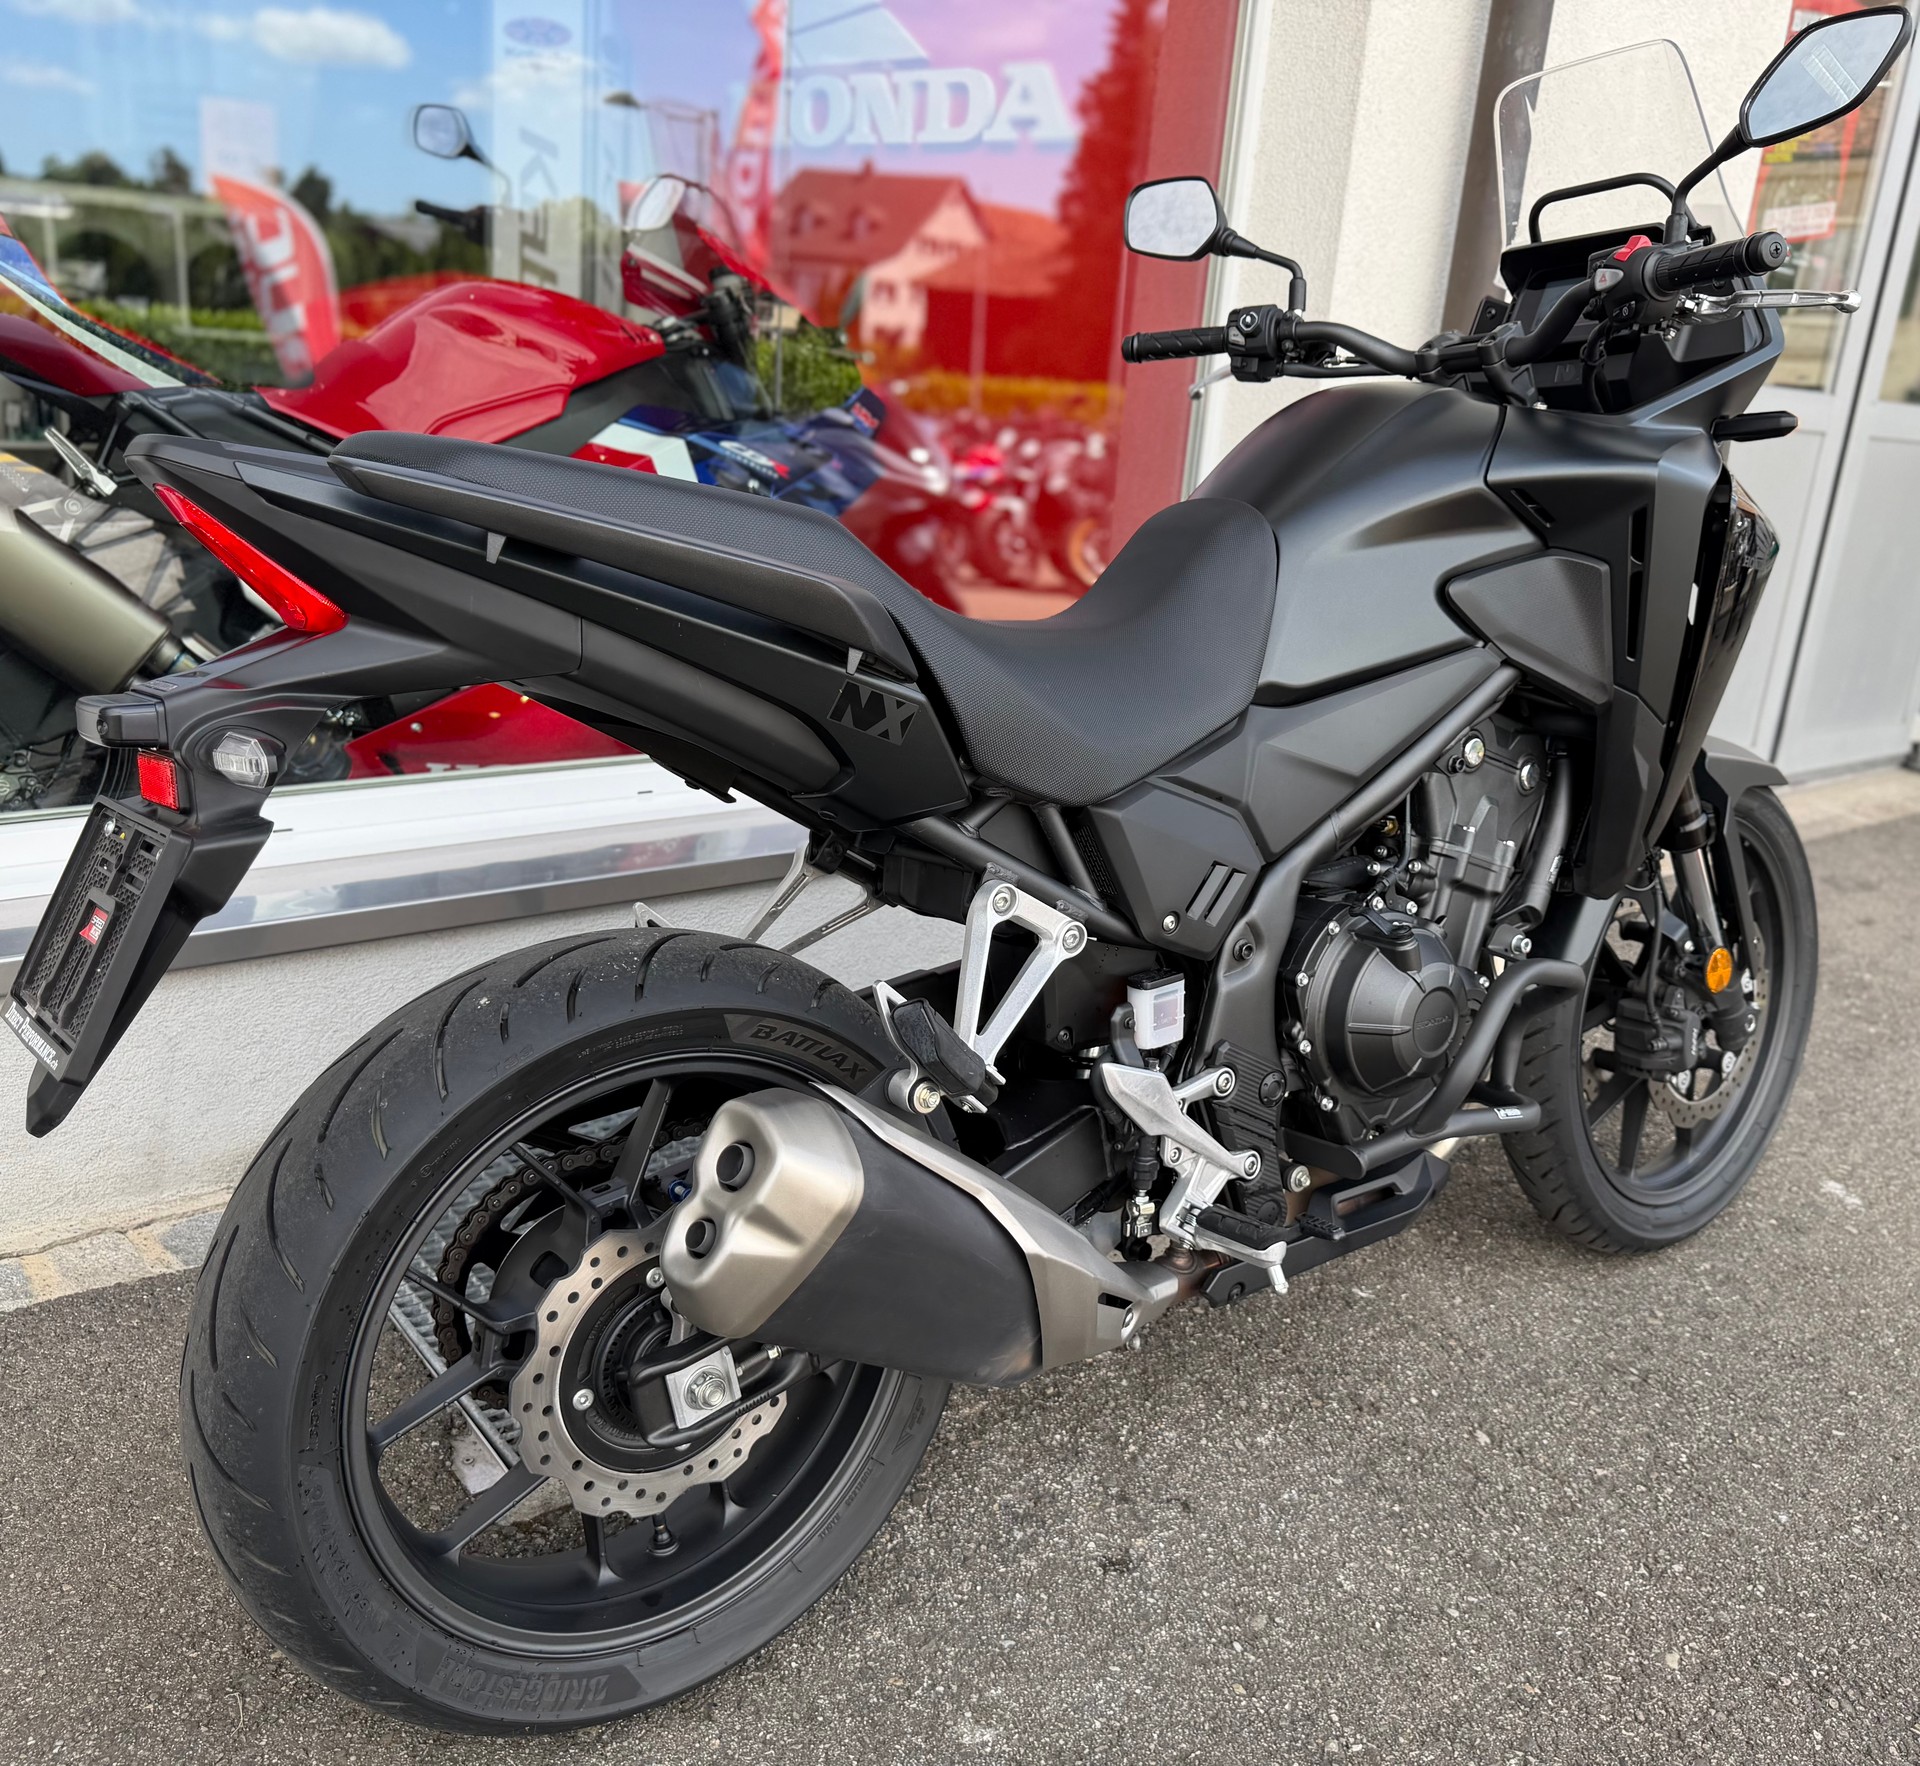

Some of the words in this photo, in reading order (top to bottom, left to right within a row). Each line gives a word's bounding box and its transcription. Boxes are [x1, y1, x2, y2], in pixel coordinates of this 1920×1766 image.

[828, 679, 919, 745] NX
[749, 1023, 869, 1081] BATTLAX
[434, 1653, 611, 1702] BRIDGESTONE
